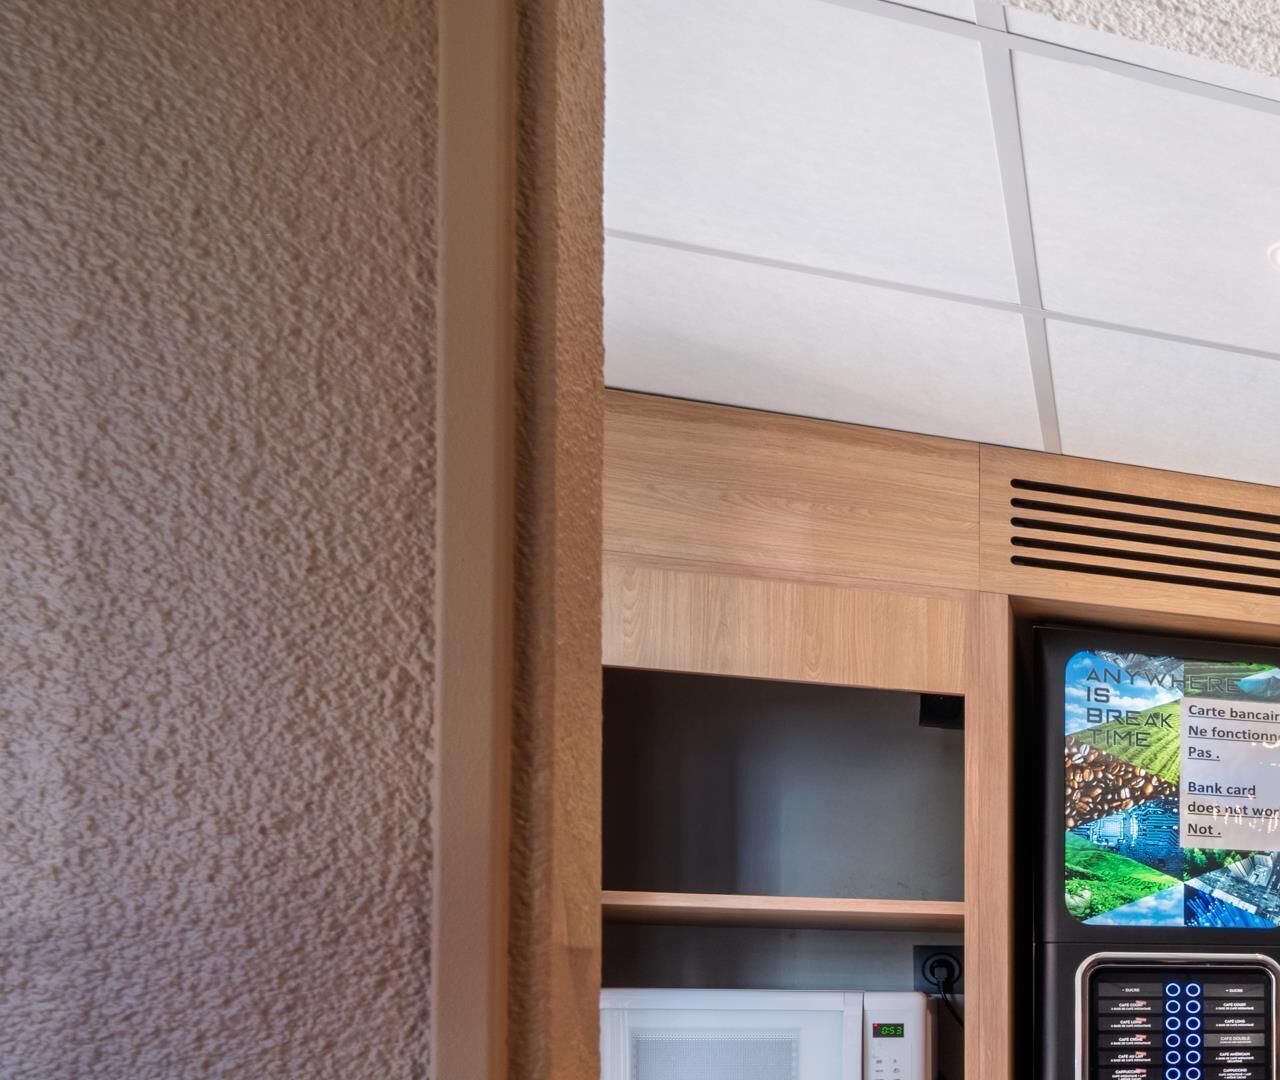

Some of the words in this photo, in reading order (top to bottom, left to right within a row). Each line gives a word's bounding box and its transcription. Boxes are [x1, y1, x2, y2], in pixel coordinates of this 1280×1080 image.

[1086, 668, 1241, 693] ANYWHERE
[1087, 687, 1110, 703] IS
[1087, 708, 1173, 729] BREAK
[1188, 704, 1226, 718] Carte
[1087, 729, 1152, 748] TIME
[1189, 725, 1209, 738] Ne
[1188, 746, 1212, 759] Pas
[1188, 781, 1222, 795] Bank
[1226, 784, 1256, 796] card
[1187, 801, 1221, 814] does
[1225, 804, 1248, 816] not
[1187, 823, 1213, 835] Not
